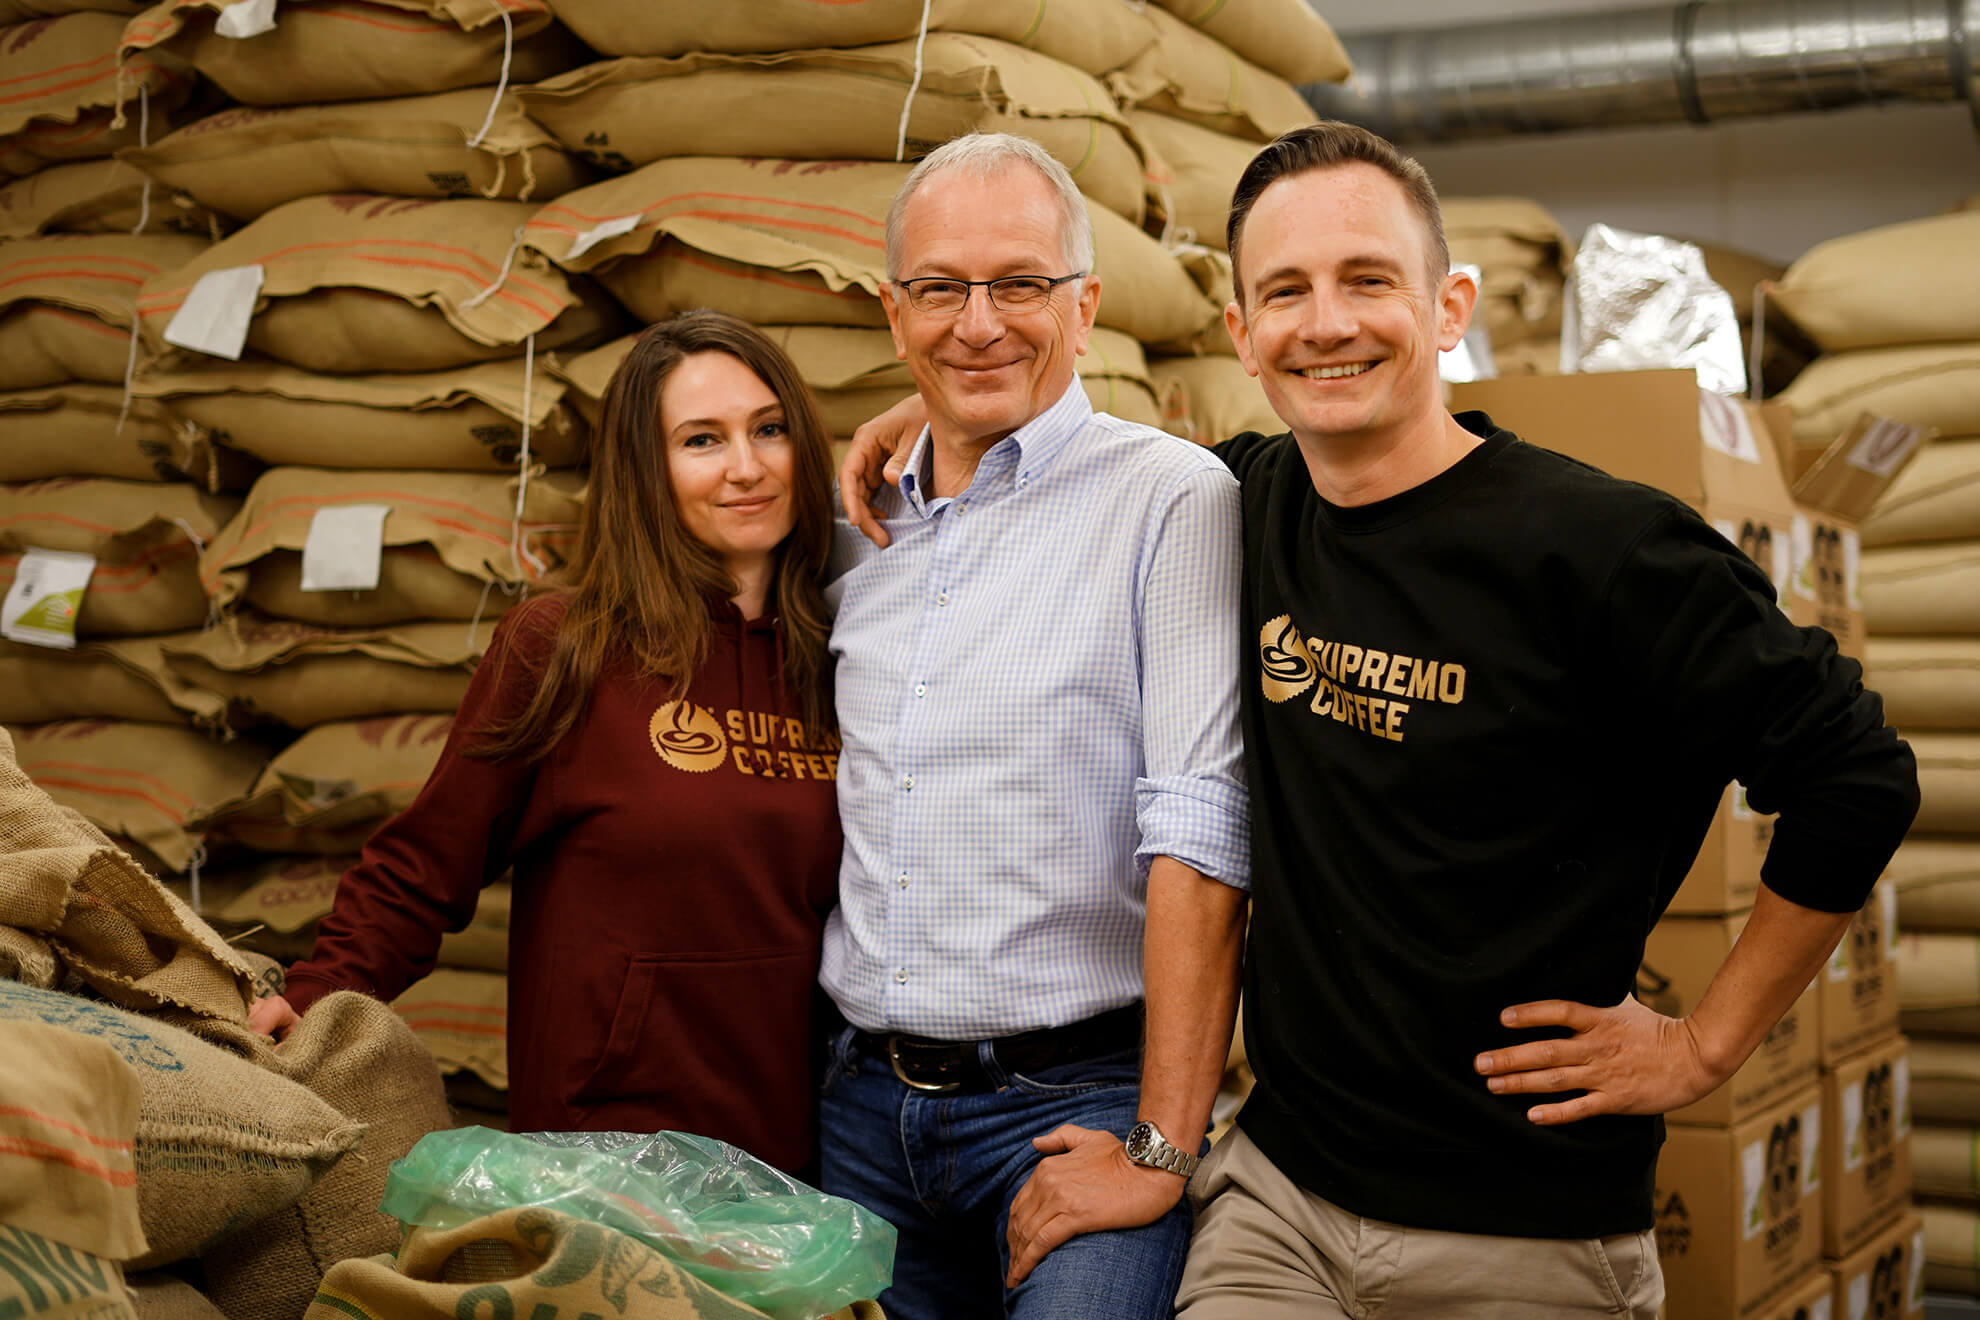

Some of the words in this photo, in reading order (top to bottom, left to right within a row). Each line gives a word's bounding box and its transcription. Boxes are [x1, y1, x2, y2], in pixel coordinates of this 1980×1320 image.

[1306, 636, 1467, 704] SUPREMO
[727, 709, 841, 751] SUPR
[1310, 677, 1411, 742] COFFEE
